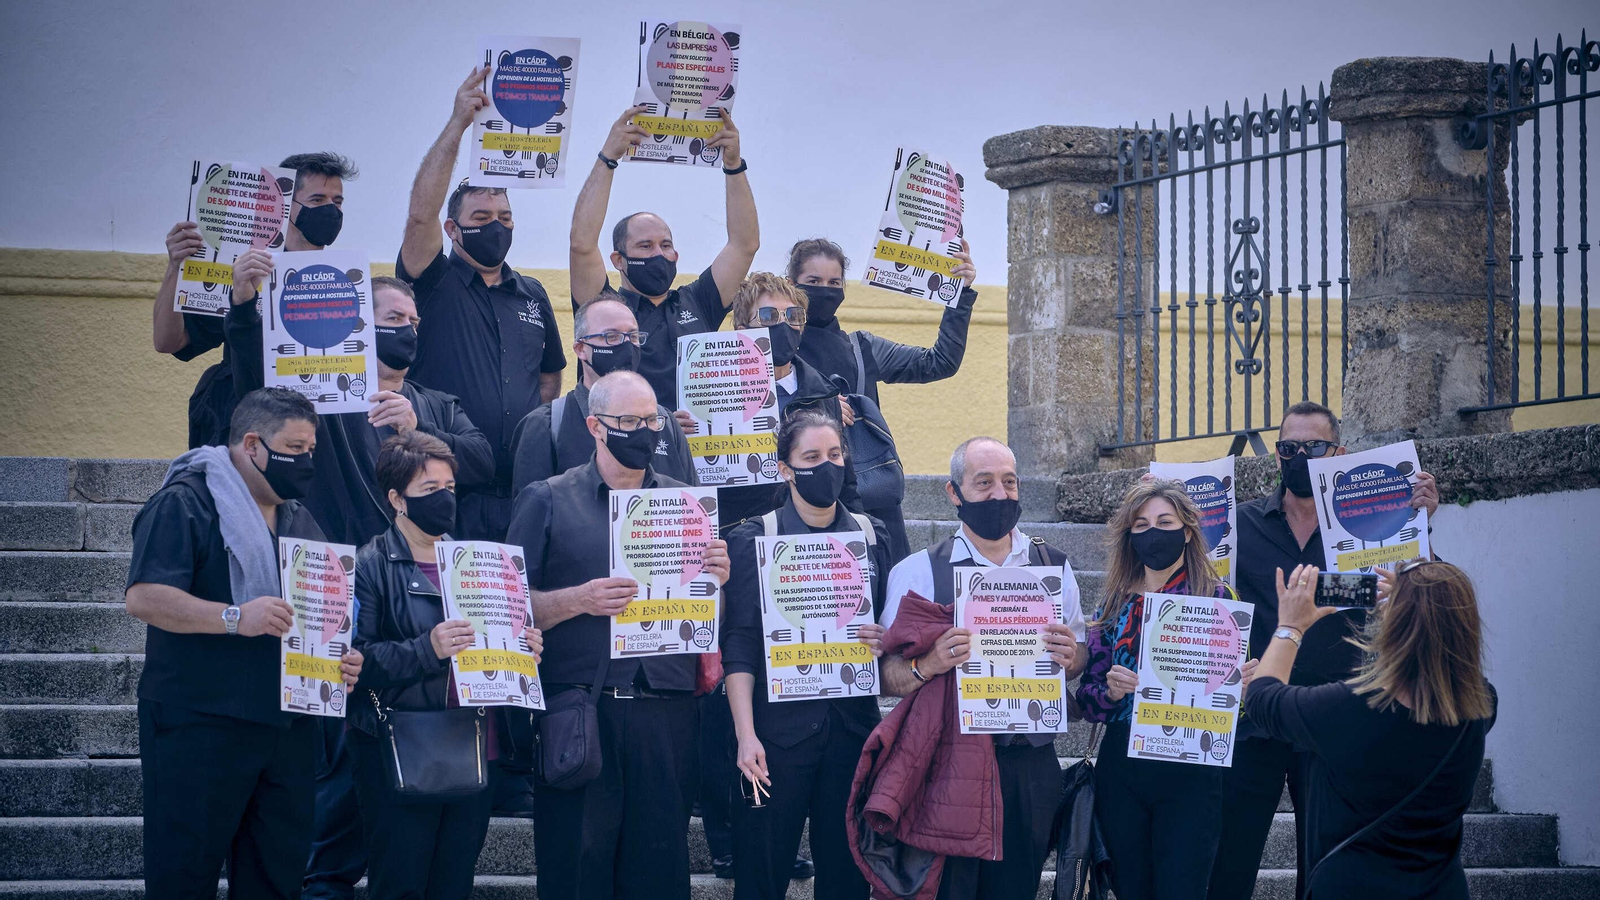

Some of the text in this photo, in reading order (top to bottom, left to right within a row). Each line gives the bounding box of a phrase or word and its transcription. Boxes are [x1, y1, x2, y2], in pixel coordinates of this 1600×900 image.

[683, 30, 715, 40] BÉLGICA
[681, 43, 717, 52] EMPRESAS
[527, 56, 547, 64] CÁDIZ
[686, 64, 725, 73] ESPECIALES
[658, 122, 699, 132] ESPAÑA
[704, 124, 718, 132] NO
[924, 160, 950, 174] EN ITALIA
[228, 170, 266, 182] EN ITALIA
[906, 183, 957, 204] DE 5.000 MILLONES
[218, 199, 236, 207] 5.000
[238, 202, 274, 212] MILLONES
[302, 272, 335, 281] EN CÁDIZ
[718, 340, 744, 349] ITALIA
[721, 368, 759, 377] MILLONES
[1363, 470, 1385, 478] CÁDIZ
[1198, 482, 1215, 491] CÁDIZ
[649, 498, 687, 507] EN ITALIA
[631, 531, 641, 539] DE
[664, 529, 702, 537] MILLONES
[808, 543, 835, 551] ITALIA
[484, 552, 504, 561] ITALIA
[781, 563, 810, 571] PAQUETE
[813, 573, 852, 581] MILLONES
[490, 582, 518, 592] MILLONES
[993, 583, 1038, 591] ALEMANIA
[1001, 594, 1044, 602] AUTONÓMOS
[1181, 606, 1219, 616] EN ITALIA
[1014, 615, 1048, 623] PÉRDIDAS
[1160, 635, 1230, 648] DE 5.000 MILLONES
[776, 647, 867, 661] EN ESPAÑA NO
[966, 682, 1055, 692] EN ESPAÑA NO
[974, 710, 1010, 718] HOSTELERÍA
